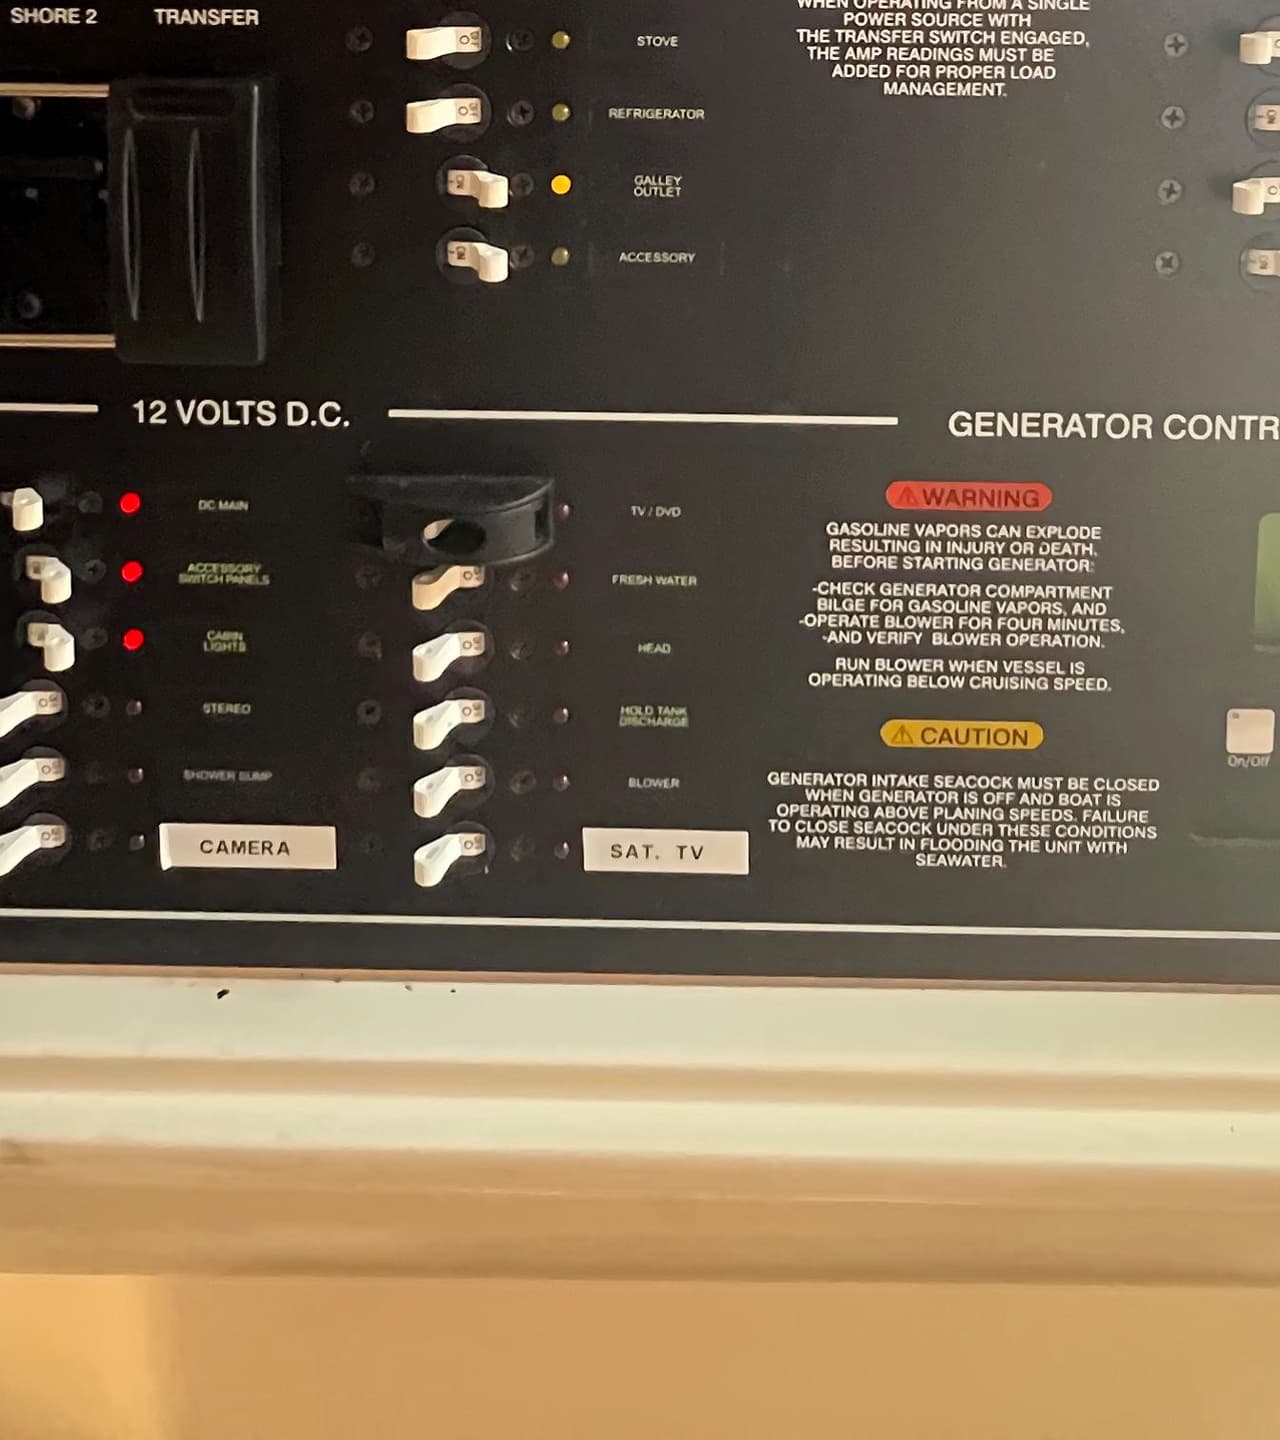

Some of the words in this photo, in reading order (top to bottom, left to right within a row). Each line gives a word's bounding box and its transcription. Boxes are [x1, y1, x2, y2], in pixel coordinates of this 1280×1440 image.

[11, 8, 80, 24] SHORE
[86, 8, 98, 25] 2
[154, 8, 259, 25] TRANSFER
[843, 12, 906, 26] POWER
[911, 13, 983, 27] SOURCE
[988, 13, 1031, 27] WITH
[637, 36, 678, 47] STOVE
[796, 29, 830, 43] THE
[835, 29, 924, 44] TRANSFER
[929, 30, 995, 44] SWITCH
[1000, 30, 1090, 47] ENGAGED,
[807, 46, 839, 60] THE
[845, 46, 882, 60] AMP
[887, 46, 974, 61] READINGS
[979, 47, 1027, 61] MUST
[1032, 48, 1054, 62] BE
[884, 81, 1007, 96] MANAGEMENT.
[609, 108, 705, 119] REFRIGERATOR
[634, 175, 682, 186] GALLEY
[633, 186, 681, 197] OUTLET
[619, 252, 696, 264] ACCESSORY
[132, 400, 167, 425] 12
[176, 400, 276, 426] VOLTS
[286, 401, 350, 427] D.C.
[948, 410, 1152, 439] GENERATOR
[198, 499, 215, 511] DC
[218, 499, 249, 511] MAIN
[922, 488, 1040, 508] WARNING
[631, 506, 646, 517] TV
[656, 506, 681, 517] DVD
[826, 522, 909, 537] GASOLINE
[914, 524, 981, 538] VAPORS
[986, 525, 1020, 538] CAN
[1026, 525, 1101, 539] EXPLODE
[829, 539, 920, 553] RESULTING
[925, 541, 941, 553] IN
[946, 541, 1005, 555] INJURY
[1010, 542, 1033, 555] OR
[187, 563, 261, 574] ACCESSORY
[832, 555, 898, 569] BEFORE
[902, 556, 983, 570] STARTING
[178, 573, 222, 584] SWITCH
[224, 574, 270, 585] PANELS
[612, 574, 652, 585] FRESH
[655, 575, 697, 586] WATER
[880, 583, 981, 598] GENERATOR
[986, 584, 1112, 599] COMPARTMENT
[817, 598, 864, 612] BILGE
[870, 599, 903, 612] FOR
[908, 599, 991, 614] GASOLINE
[1072, 602, 1106, 615] AND
[884, 616, 953, 629] BLOWER
[959, 617, 992, 630] FOR
[997, 618, 1042, 631] FOUR
[1048, 618, 1125, 634] MINUTES,
[206, 630, 243, 641] CABIN
[203, 641, 247, 653] LIGHTS
[638, 643, 671, 654] HEAD
[836, 658, 870, 671] RUN
[875, 658, 944, 672] BLOWER
[949, 659, 998, 673] WHEN
[1003, 661, 1066, 675] VESSEL
[1070, 662, 1085, 674] IS
[808, 673, 902, 688] OPERATING
[907, 675, 965, 689] BELOW
[970, 676, 1049, 690] CRUISING
[1054, 677, 1111, 691] SPEED.
[202, 703, 251, 715] STEREO
[620, 705, 653, 715] HOLD
[657, 705, 687, 715] TANK
[620, 716, 689, 728] DISCHARGE
[921, 727, 1028, 746] CAUTION
[1228, 755, 1270, 768] On/Off
[183, 769, 236, 781] SHOWER
[628, 777, 680, 788] BLOWER
[767, 772, 867, 788] GENERATOR
[872, 773, 928, 788] INTAKE
[934, 775, 1013, 790] SEACOCK
[1017, 776, 1063, 790] MUST
[1068, 777, 1088, 791] BE
[1093, 777, 1159, 792] CLOSED
[776, 804, 869, 818] OPERATING
[875, 805, 928, 820] ABOVE
[933, 806, 1004, 821] PLANING
[1009, 807, 1077, 822] SPEEDS.
[1083, 809, 1149, 823] FAILURE
[768, 820, 790, 833] TO
[795, 820, 848, 834] CLOSE
[853, 821, 931, 835] SEACOCK
[936, 822, 993, 837] UNDER
[998, 823, 1050, 837] THESE
[1055, 824, 1157, 839] CONDITIONS
[200, 839, 291, 856] CAMERA
[611, 844, 660, 859] SAT.
[677, 845, 704, 859] TV
[916, 853, 1007, 868] SEAWATER.
